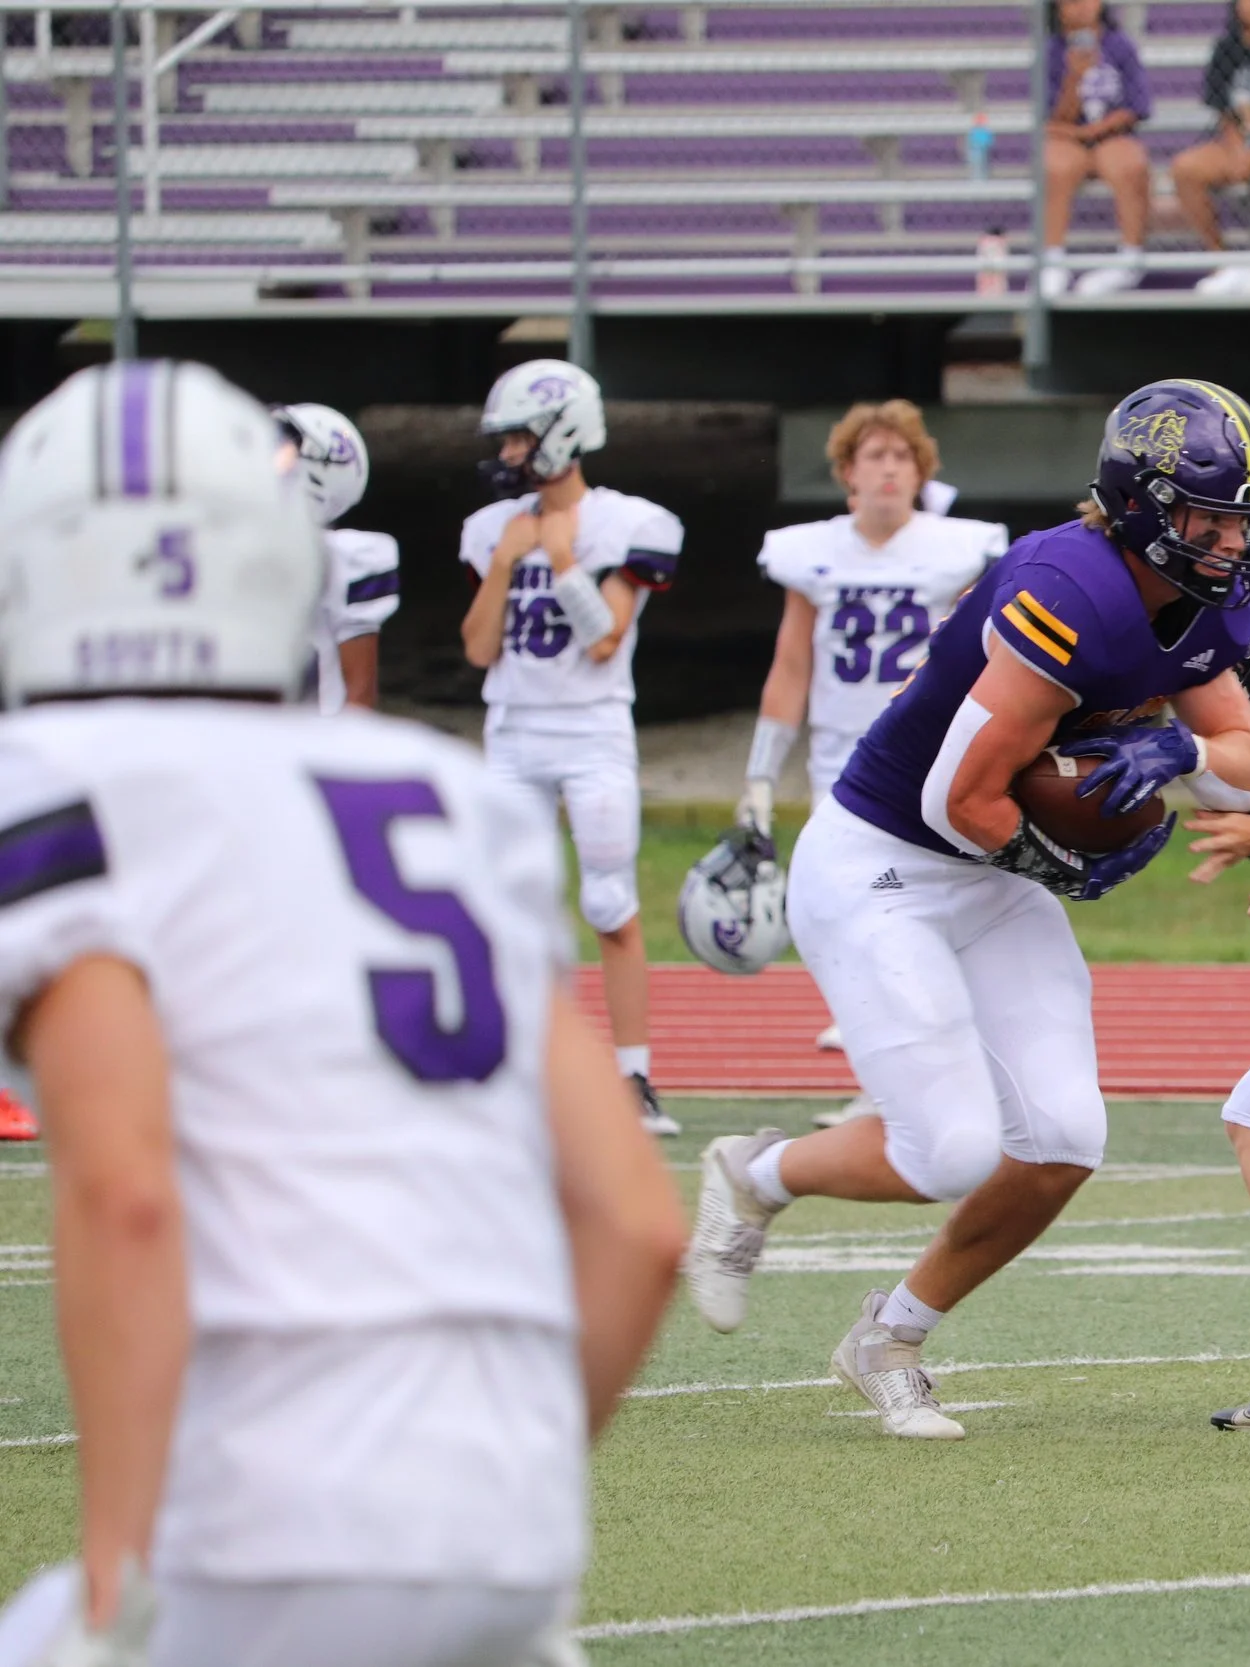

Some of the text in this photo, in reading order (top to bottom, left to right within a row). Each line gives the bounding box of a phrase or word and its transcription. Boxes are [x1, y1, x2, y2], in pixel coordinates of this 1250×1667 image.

[158, 527, 195, 600] 5
[832, 601, 930, 683] 32
[307, 773, 506, 1084] 5
